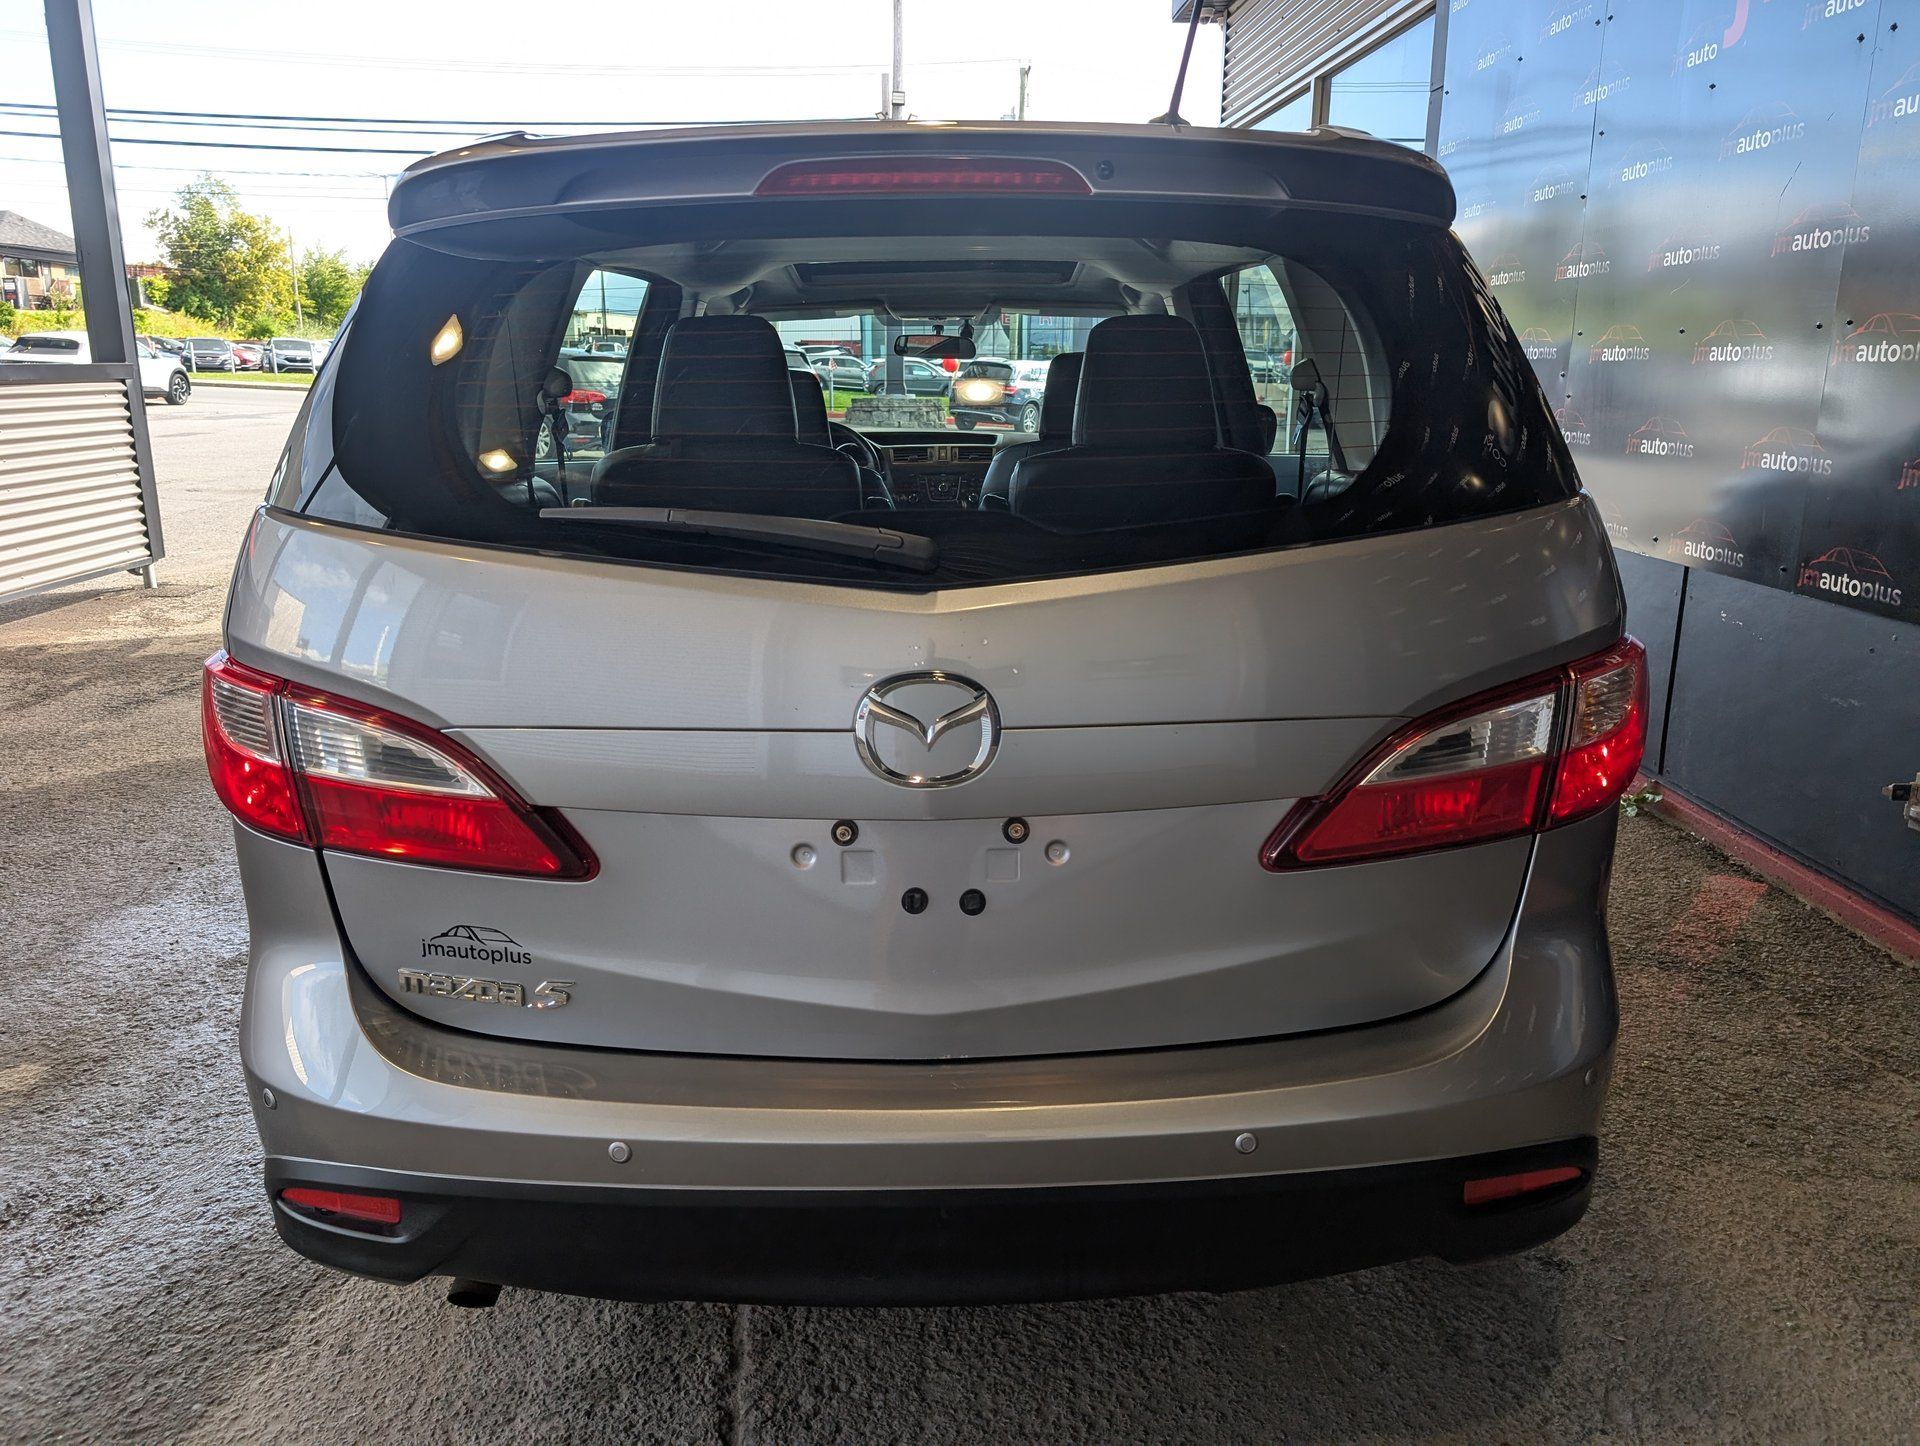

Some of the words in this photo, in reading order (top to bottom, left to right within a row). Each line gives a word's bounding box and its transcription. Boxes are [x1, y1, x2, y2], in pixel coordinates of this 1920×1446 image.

[1771, 222, 1871, 257] jmautoplus
[1554, 259, 1611, 282] jmautoplus
[1647, 243, 1721, 272] jmautoplus
[1588, 344, 1650, 364] jmautoplus
[1692, 342, 1773, 365] jmautoplus
[1625, 433, 1694, 458] jmautoplus
[1740, 446, 1833, 475] jmautoplus
[1667, 533, 1744, 568] jmautoplus
[1797, 563, 1902, 606] jmautoplus
[421, 939, 532, 965] jmautoplus
